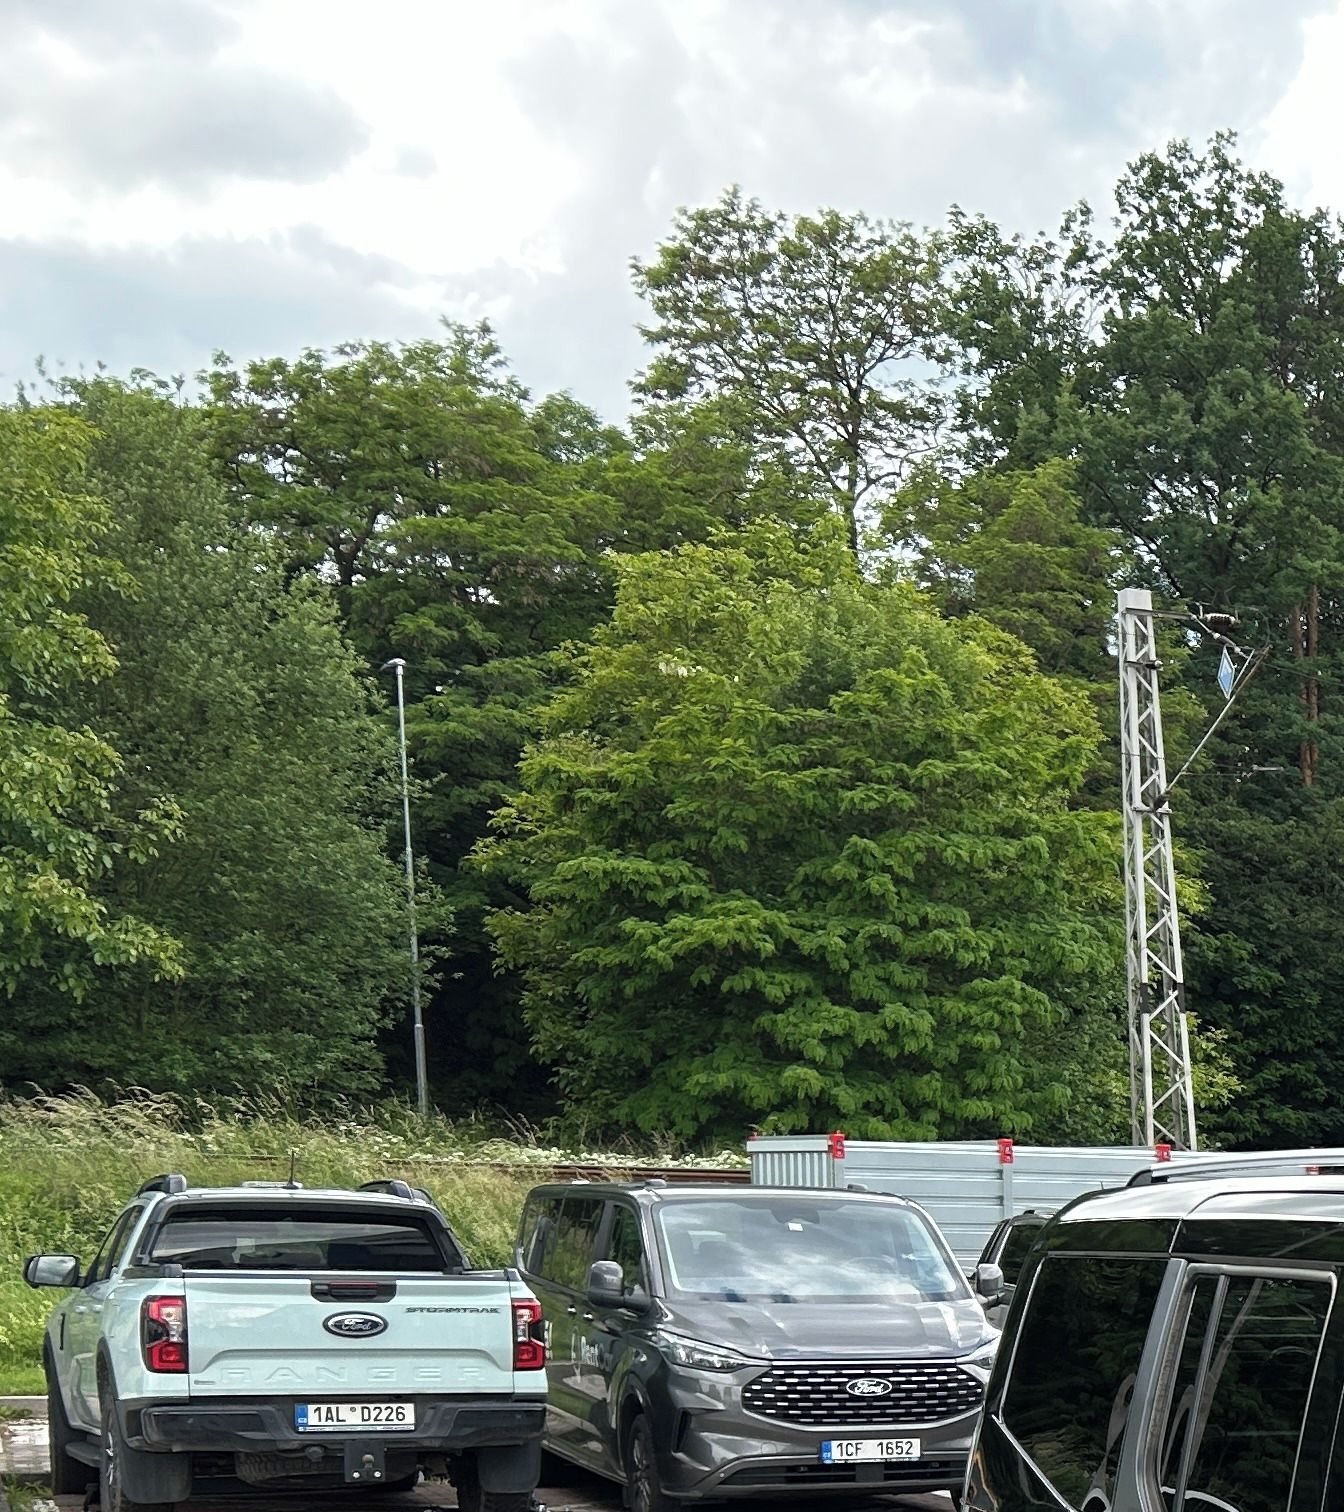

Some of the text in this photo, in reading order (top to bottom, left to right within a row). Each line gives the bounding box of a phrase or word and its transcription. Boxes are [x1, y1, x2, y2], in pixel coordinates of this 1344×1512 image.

[405, 1306, 502, 1314] STORMTRAK
[341, 1318, 372, 1331] Ford
[219, 1366, 488, 1383] RANGER
[854, 1379, 885, 1394] Ford
[313, 1406, 406, 1423] 1AL D226
[836, 1440, 914, 1457] 1CF 1652
